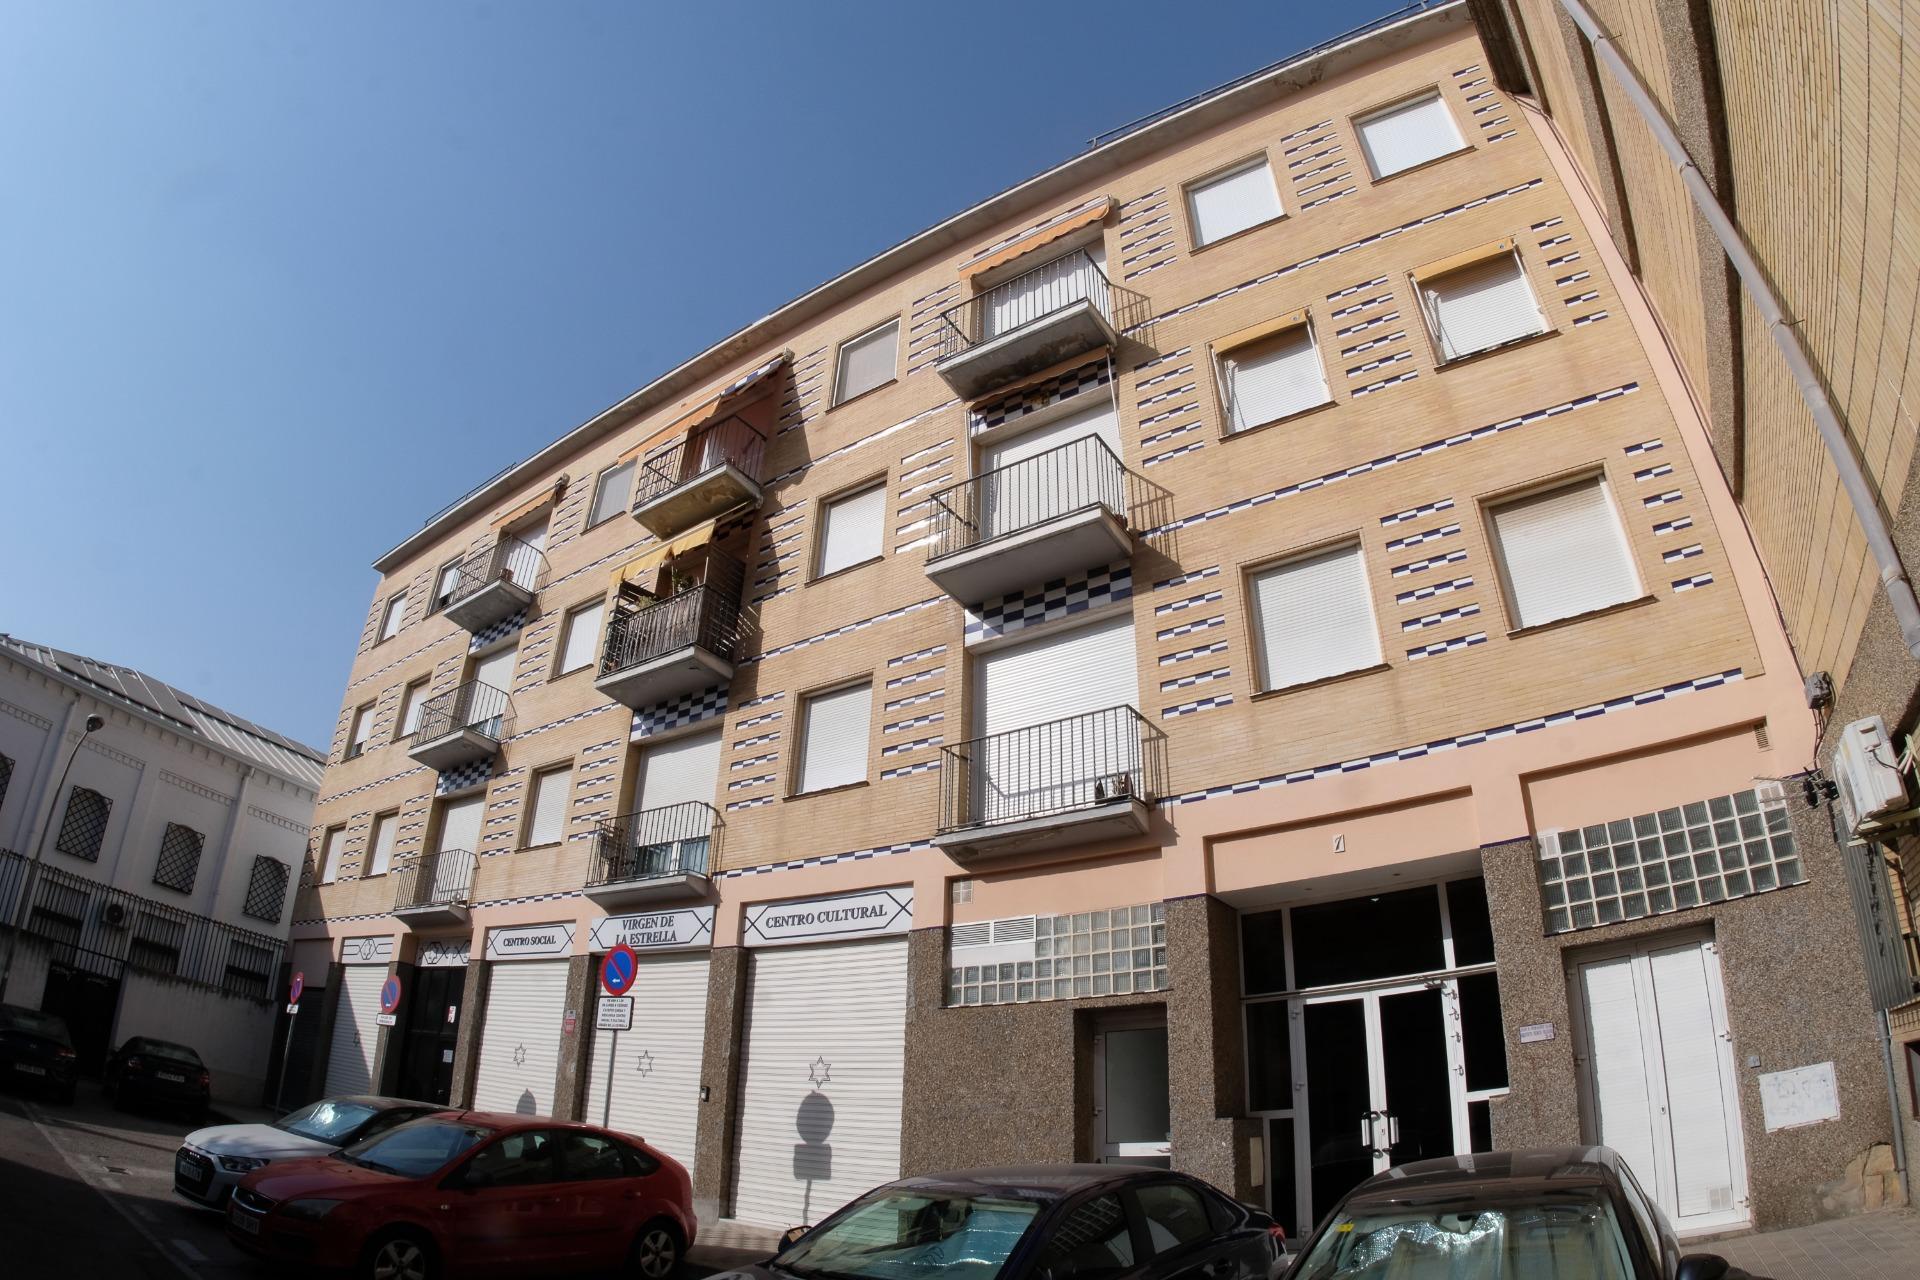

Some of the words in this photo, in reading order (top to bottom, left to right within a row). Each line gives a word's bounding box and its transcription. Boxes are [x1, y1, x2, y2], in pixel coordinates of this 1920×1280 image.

[622, 917, 658, 931] VIRGEN
[659, 915, 675, 928] DE
[766, 913, 814, 929] CENTRO
[816, 904, 887, 923] CULTURAL
[503, 936, 530, 946] CENTRO
[531, 935, 556, 945] SOCIAL
[616, 933, 629, 944] LA
[630, 930, 677, 943] ESTRELLA
